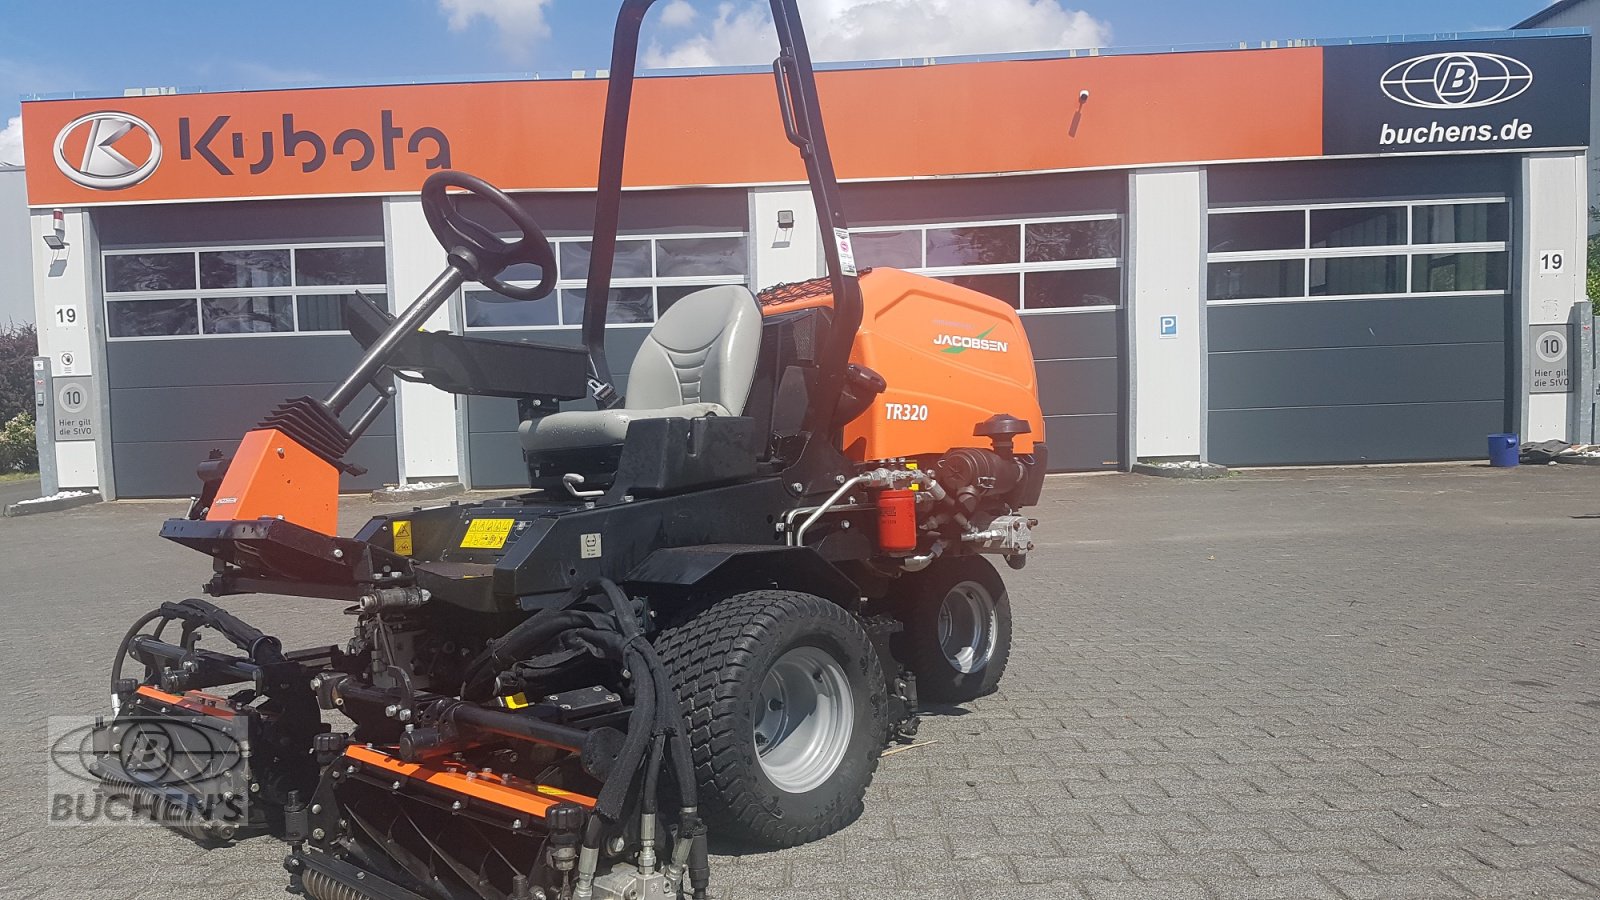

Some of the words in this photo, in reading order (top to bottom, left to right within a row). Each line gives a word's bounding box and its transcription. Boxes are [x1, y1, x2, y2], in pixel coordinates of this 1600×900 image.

[1379, 118, 1533, 145] buchens.de
[178, 109, 452, 176] Kubota
[1541, 253, 1563, 270] 19
[56, 308, 76, 323] 19
[1162, 318, 1175, 333] P
[933, 334, 1008, 353] JACOBSEN
[1543, 339, 1559, 354] 10
[1534, 369, 1552, 377] Hier
[1534, 379, 1547, 387] die
[1550, 378, 1570, 387] StVO
[66, 390, 81, 405] 10
[885, 403, 929, 421] TR320
[59, 419, 75, 427] Hier
[78, 418, 91, 428] gilt
[73, 427, 92, 436] StVO
